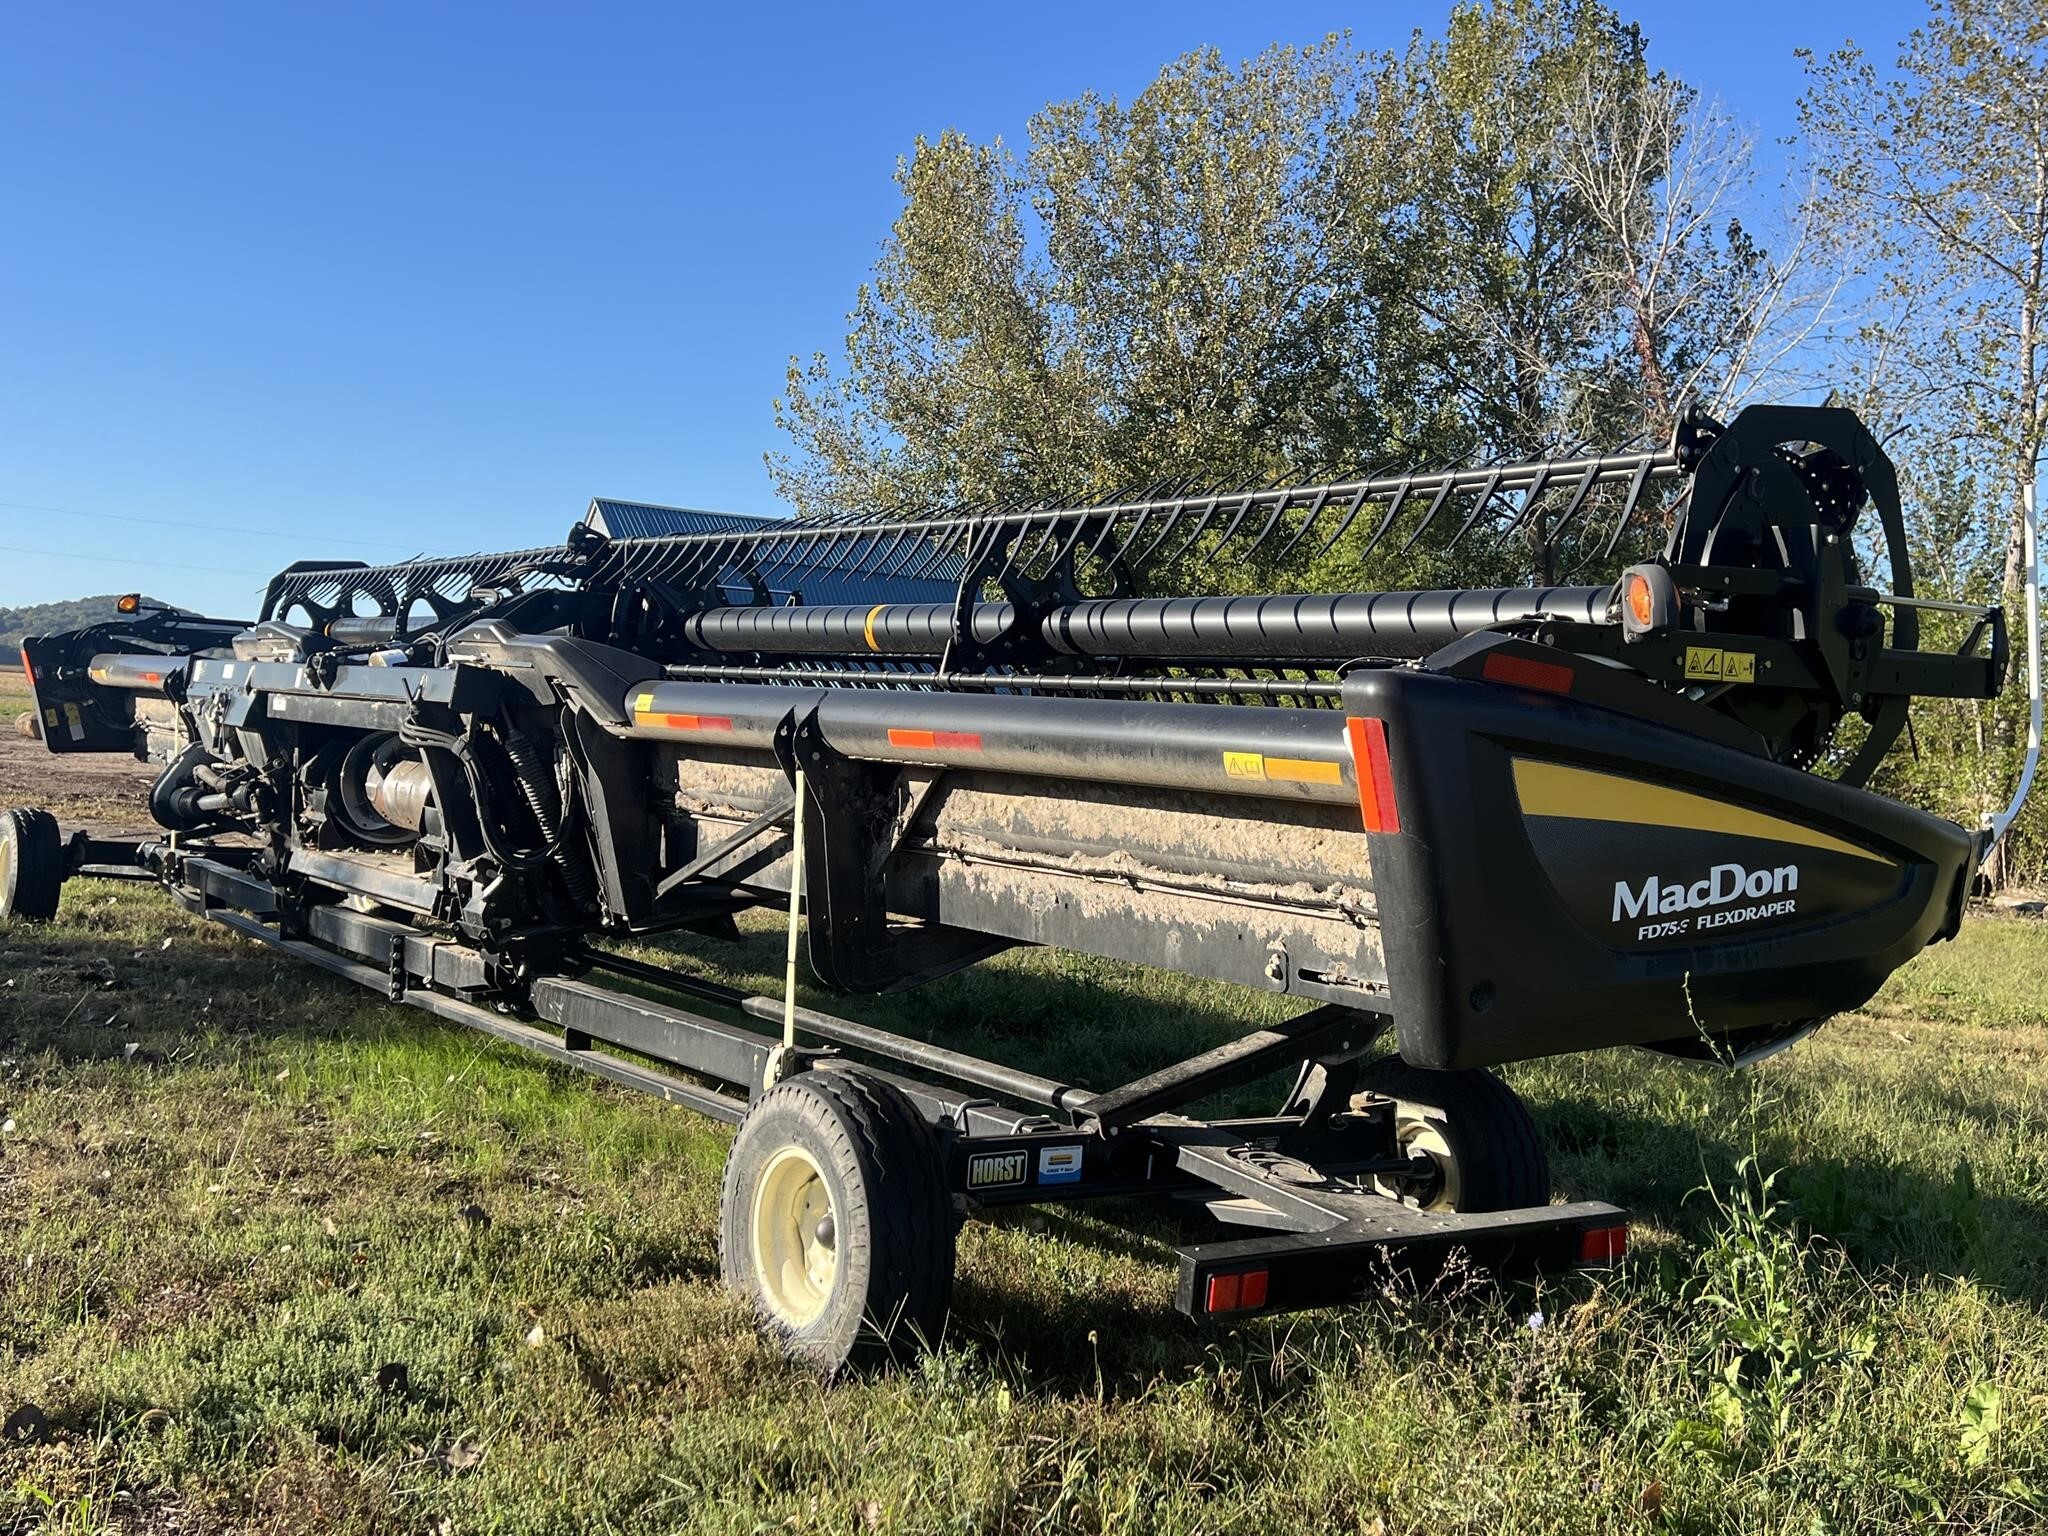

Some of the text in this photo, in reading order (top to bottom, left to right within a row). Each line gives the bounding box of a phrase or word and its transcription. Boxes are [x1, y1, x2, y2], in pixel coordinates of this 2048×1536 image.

[1612, 863, 1798, 922] MacDon
[1697, 900, 1796, 930] FLEXDRAPER
[972, 1155, 1025, 1184] HORST
